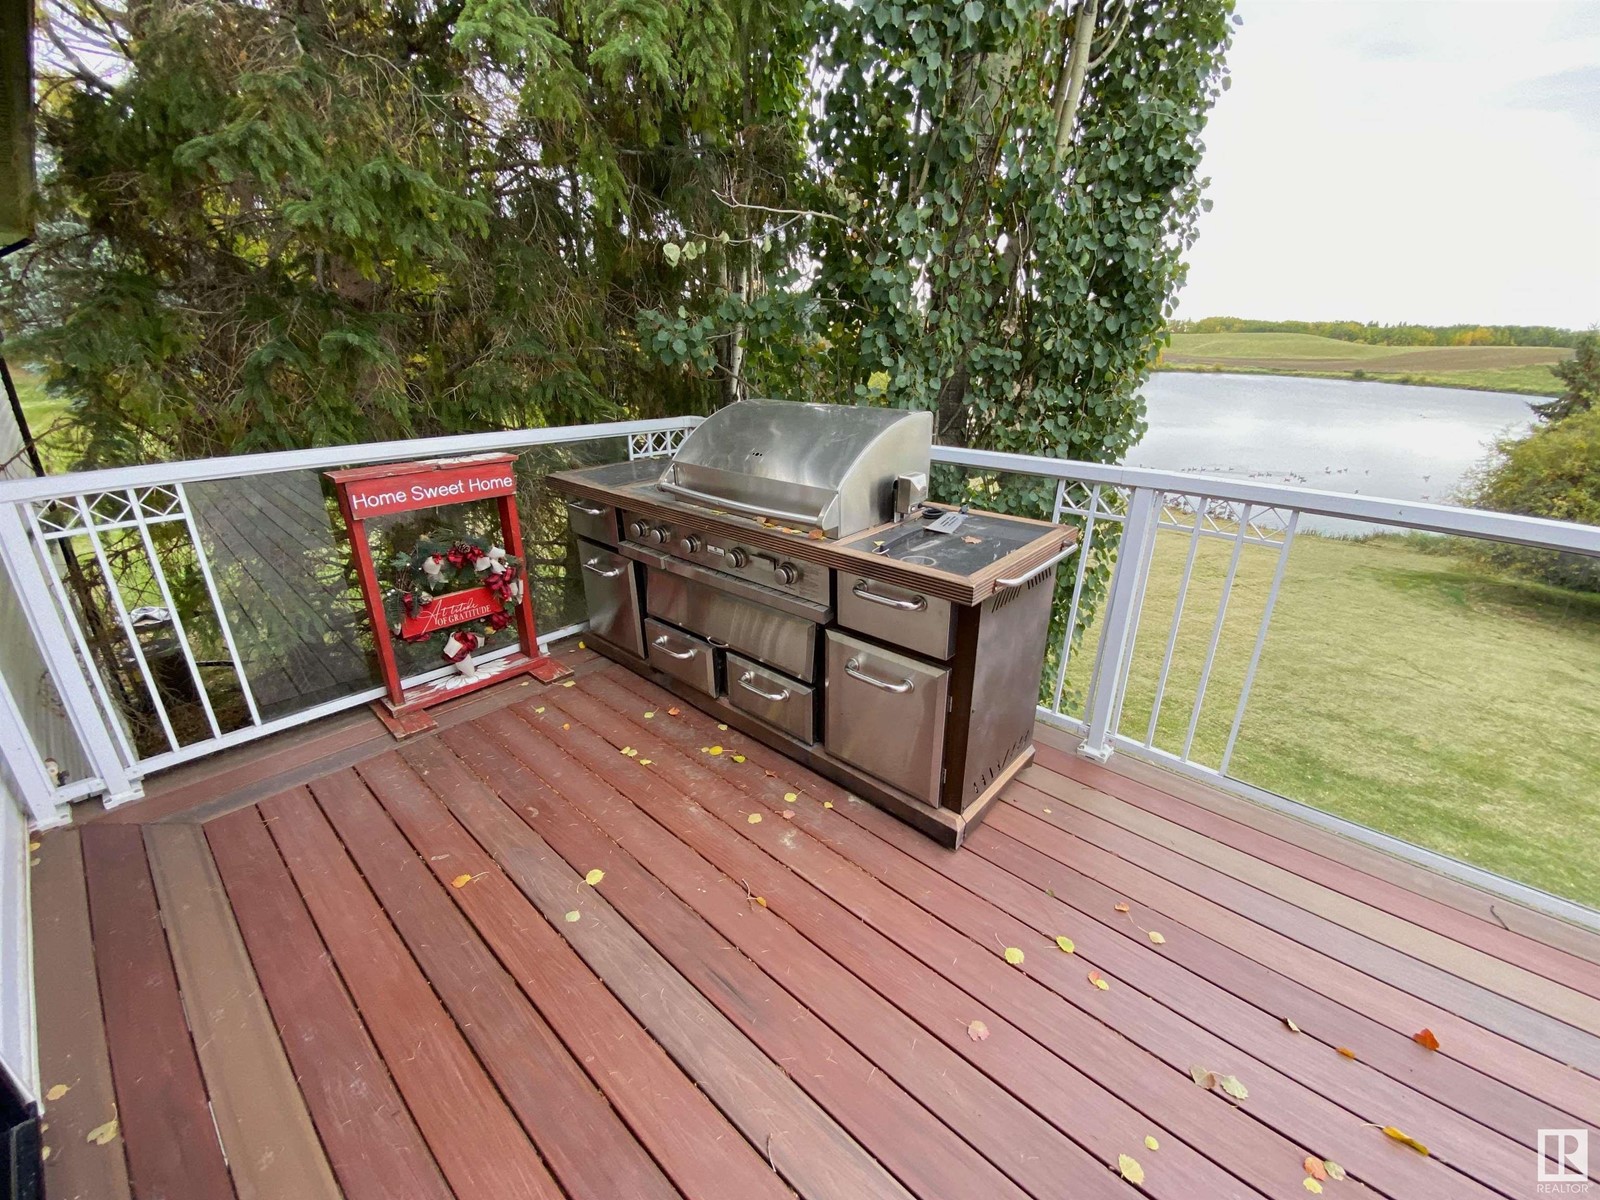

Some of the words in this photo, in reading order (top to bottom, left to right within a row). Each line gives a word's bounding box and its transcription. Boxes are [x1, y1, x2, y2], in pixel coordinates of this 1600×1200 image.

[352, 490, 407, 510] Home
[411, 479, 465, 501] Sweet
[468, 476, 513, 493] Home
[437, 616, 449, 627] OF
[448, 604, 492, 624] GRATITUDE
